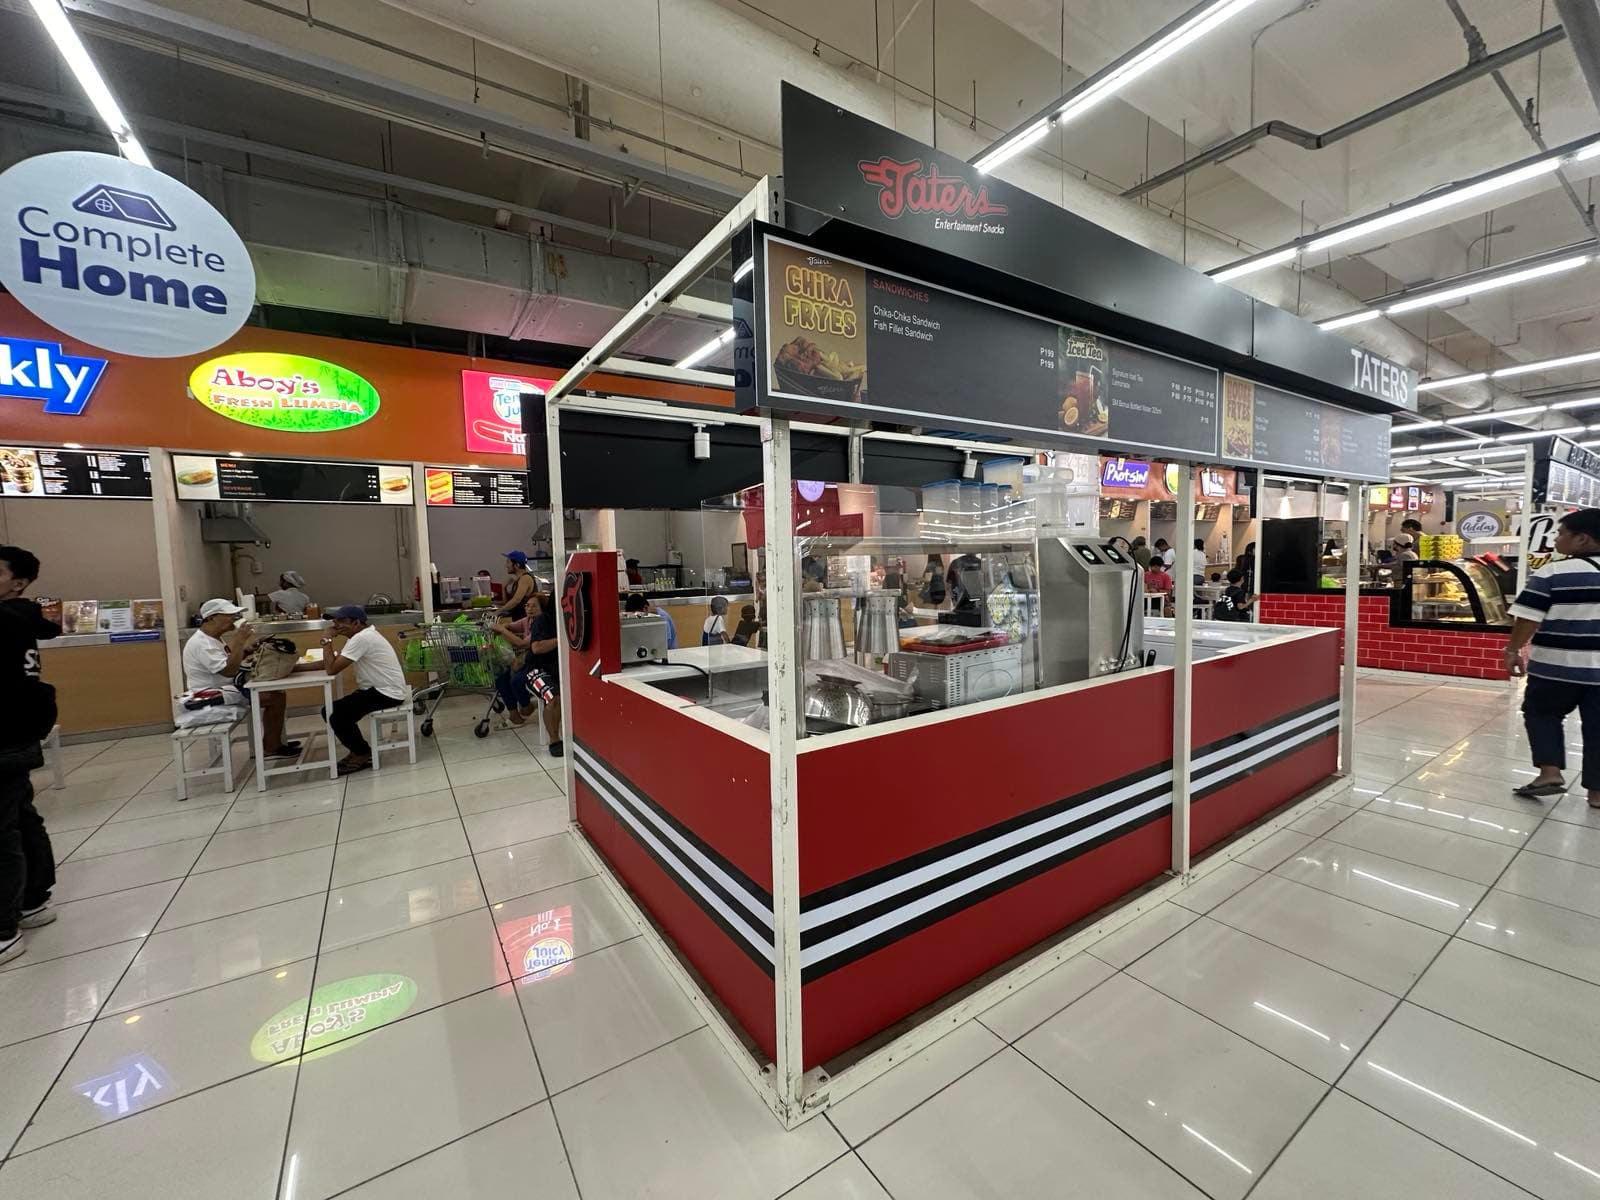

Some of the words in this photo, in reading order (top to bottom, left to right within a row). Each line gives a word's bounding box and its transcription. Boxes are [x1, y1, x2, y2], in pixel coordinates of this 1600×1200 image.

[858, 157, 1008, 219] Taters
[18, 206, 225, 273] Complete
[935, 218, 982, 232] Entertainment
[982, 223, 1005, 234] Snacks
[20, 237, 228, 315] Home
[785, 264, 853, 308] CHIKA
[873, 279, 929, 303] SANDWICHES
[784, 296, 856, 339] FRYES
[874, 305, 911, 323] Chika-Chika
[912, 314, 940, 330] Sandwich
[874, 319, 888, 331] Fish
[904, 327, 934, 341] Sandwich
[1040, 347, 1054, 358] P199
[1068, 341, 1087, 358] Iced
[1088, 344, 1102, 360] Tea
[212, 367, 320, 396] Aboy's
[1350, 348, 1408, 403] TATERS
[213, 394, 273, 408] FRESH
[280, 397, 364, 415] LUMPIA
